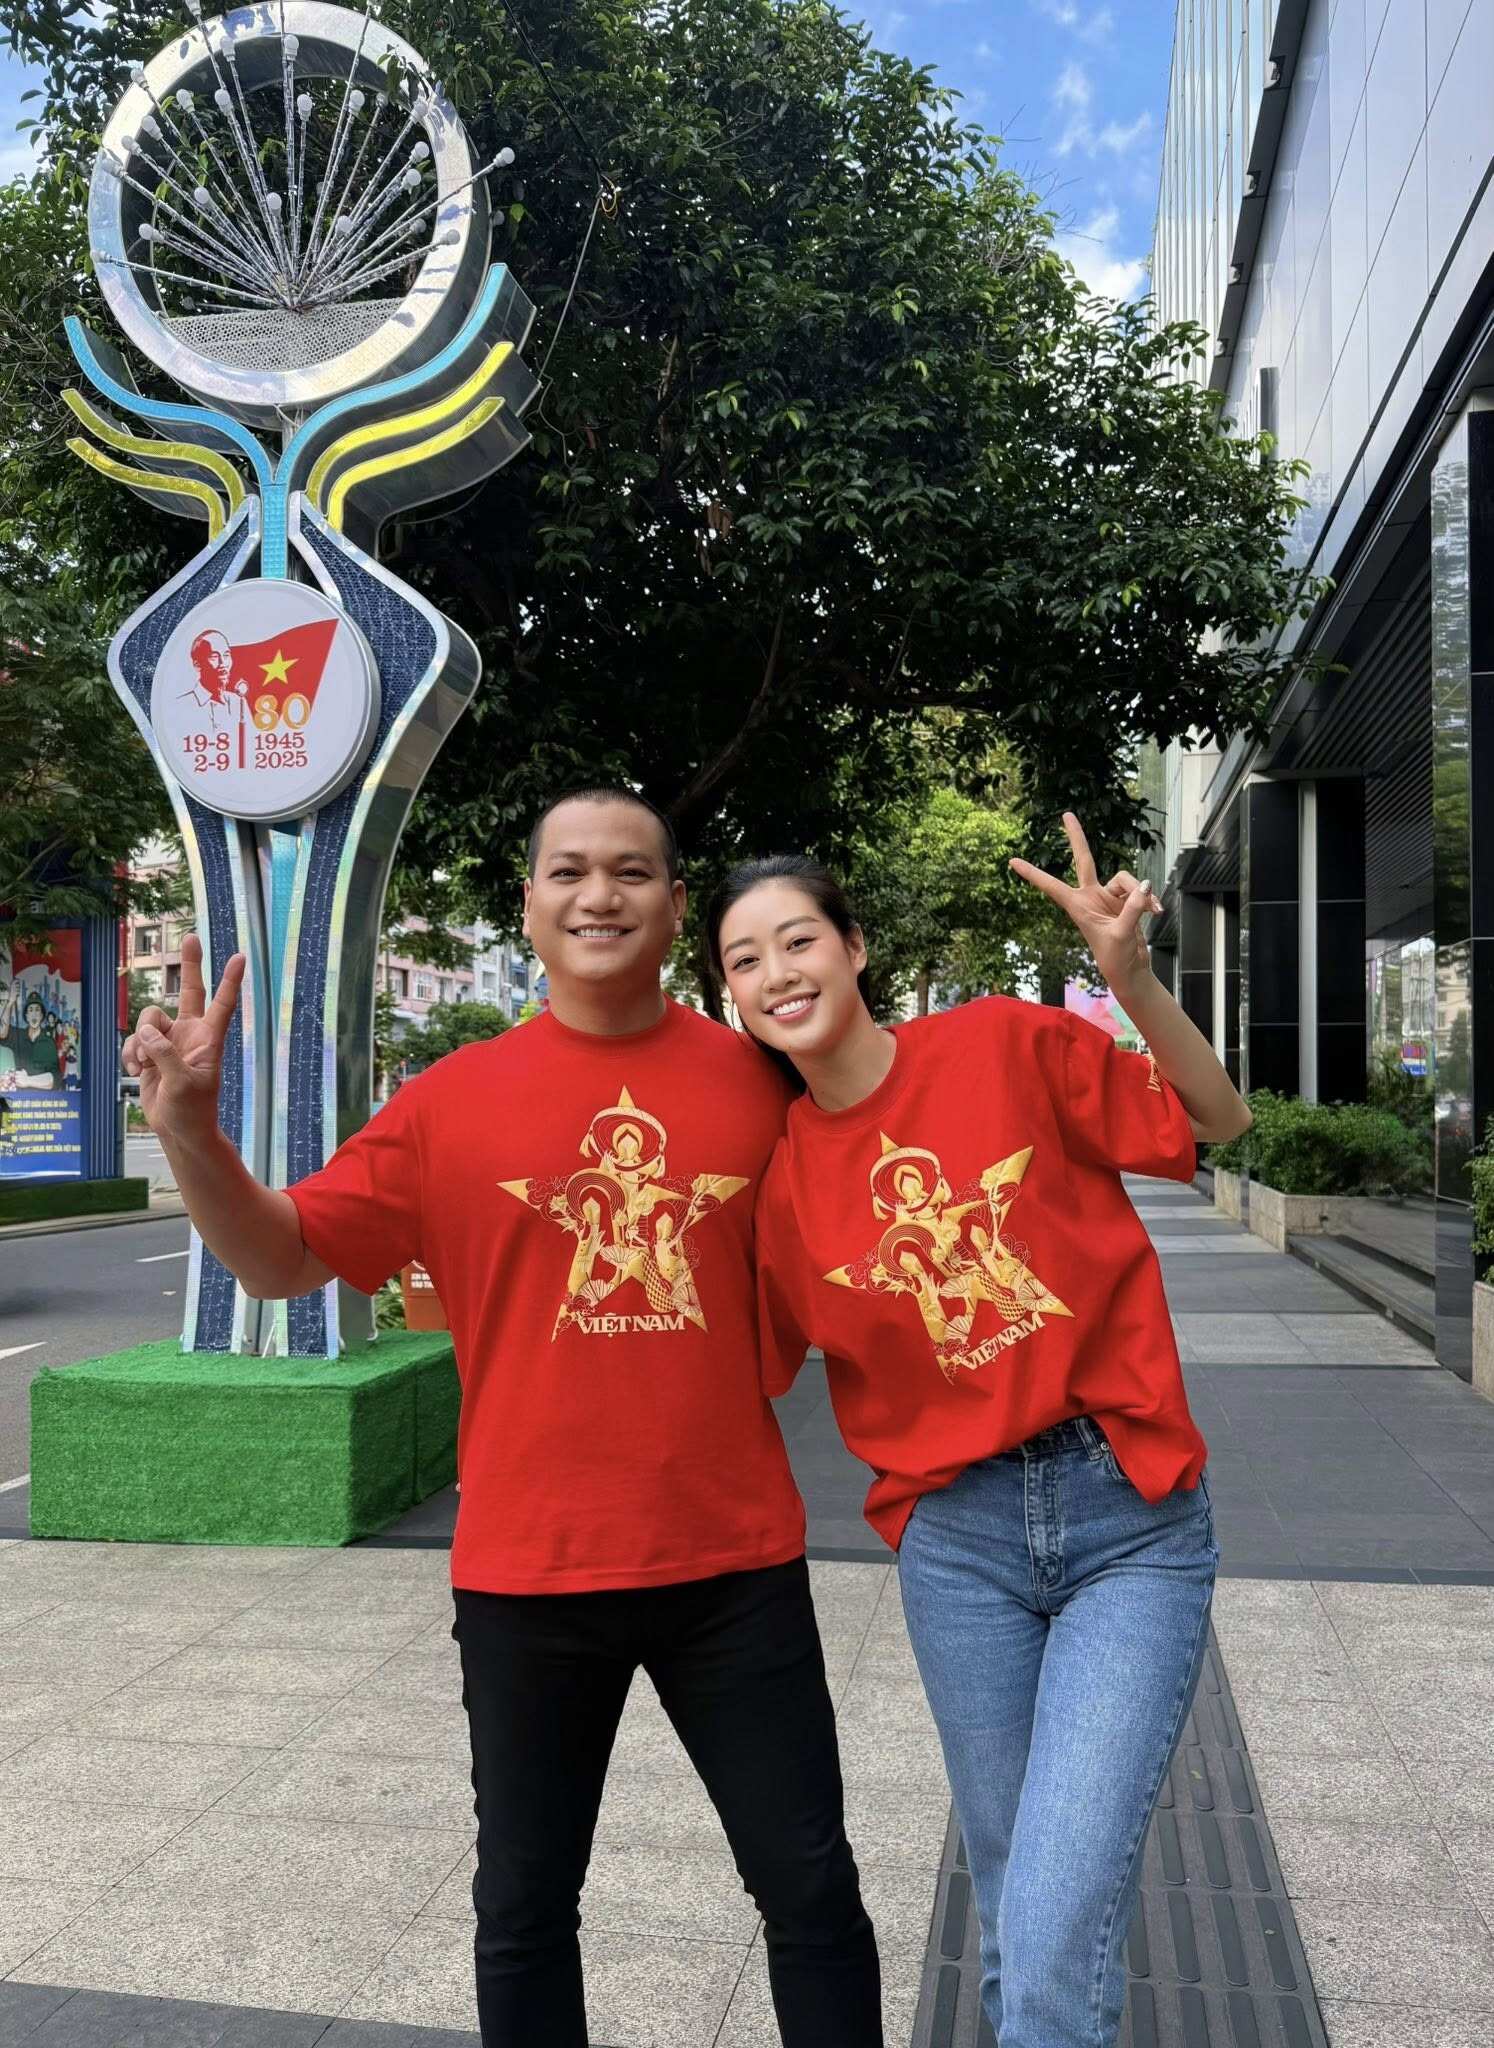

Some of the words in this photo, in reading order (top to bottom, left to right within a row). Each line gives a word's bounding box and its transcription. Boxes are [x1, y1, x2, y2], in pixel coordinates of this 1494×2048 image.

[254, 692, 311, 731] 80
[183, 732, 230, 753] 19-8
[255, 732, 305, 751] 1945
[194, 752, 230, 773] 2-9
[255, 750, 308, 769] 2025
[632, 1314, 687, 1332] NAM
[996, 1311, 1046, 1350] NAM
